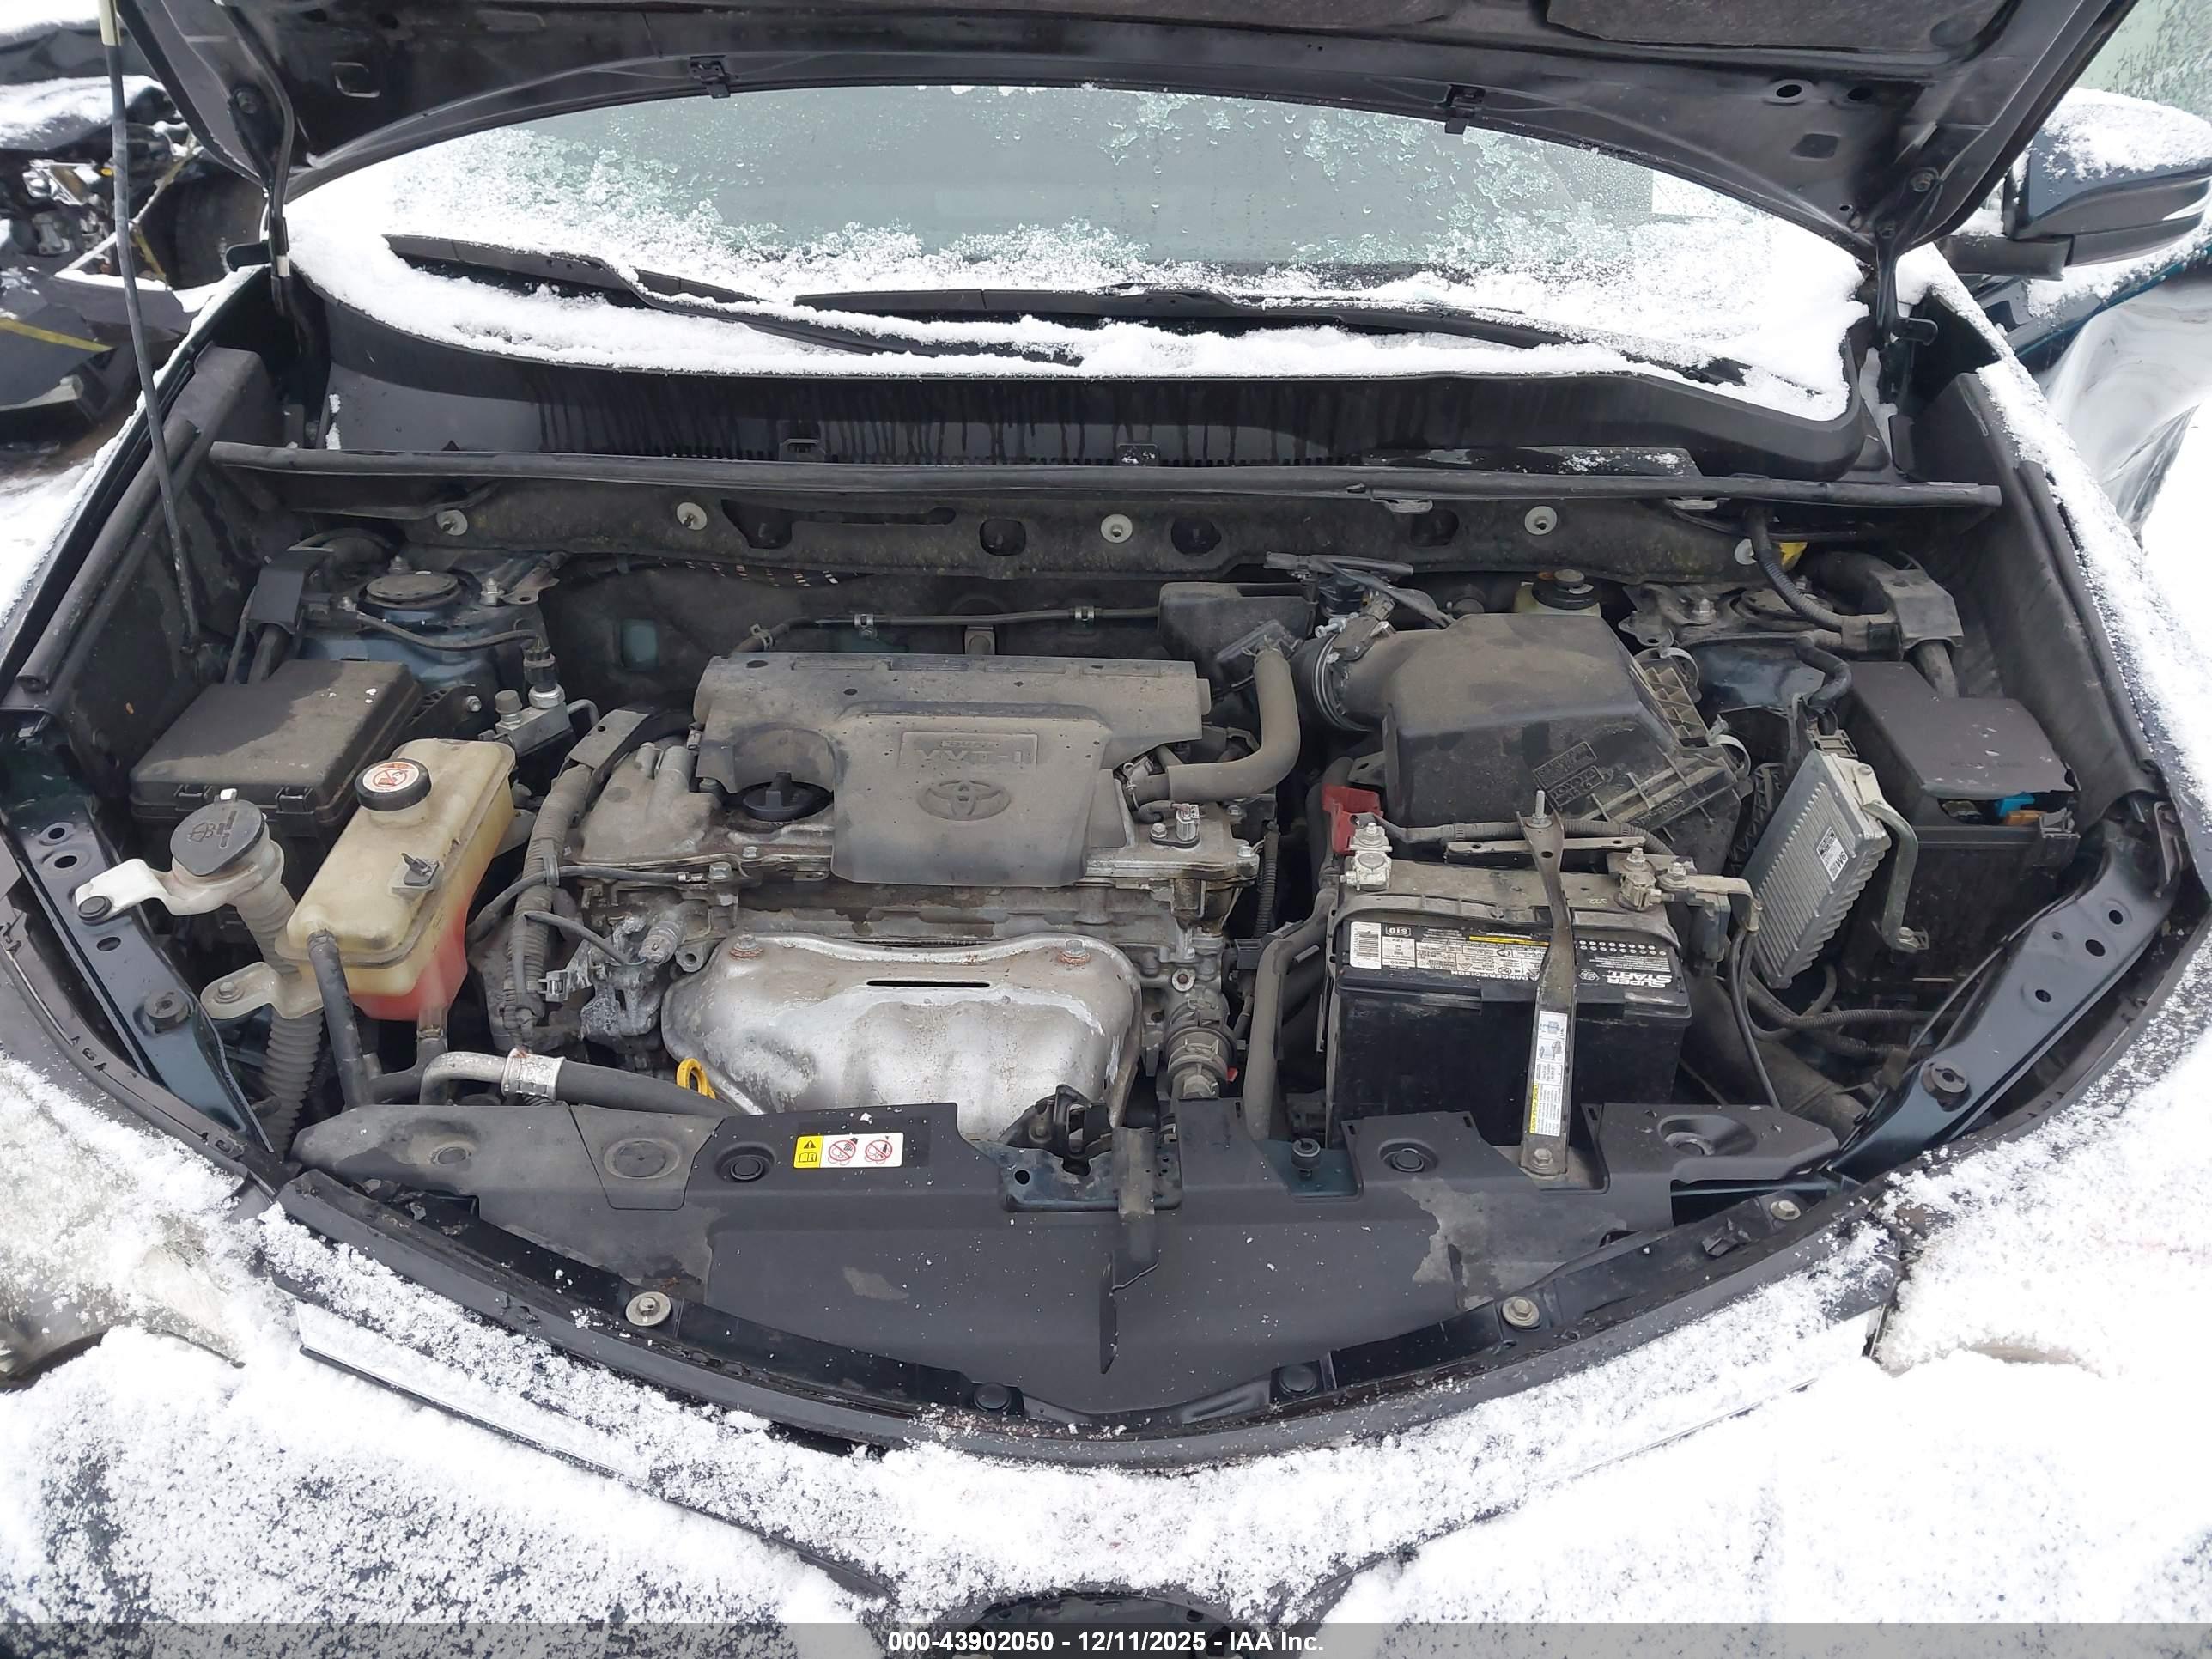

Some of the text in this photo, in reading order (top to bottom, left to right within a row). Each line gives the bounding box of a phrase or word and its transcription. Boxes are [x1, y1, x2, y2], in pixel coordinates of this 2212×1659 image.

[1835, 851, 1848, 869] W6
[1450, 970, 1529, 981] DANGER/POISON
[1606, 970, 1670, 983] START
[1607, 978, 1665, 988] SUPER
